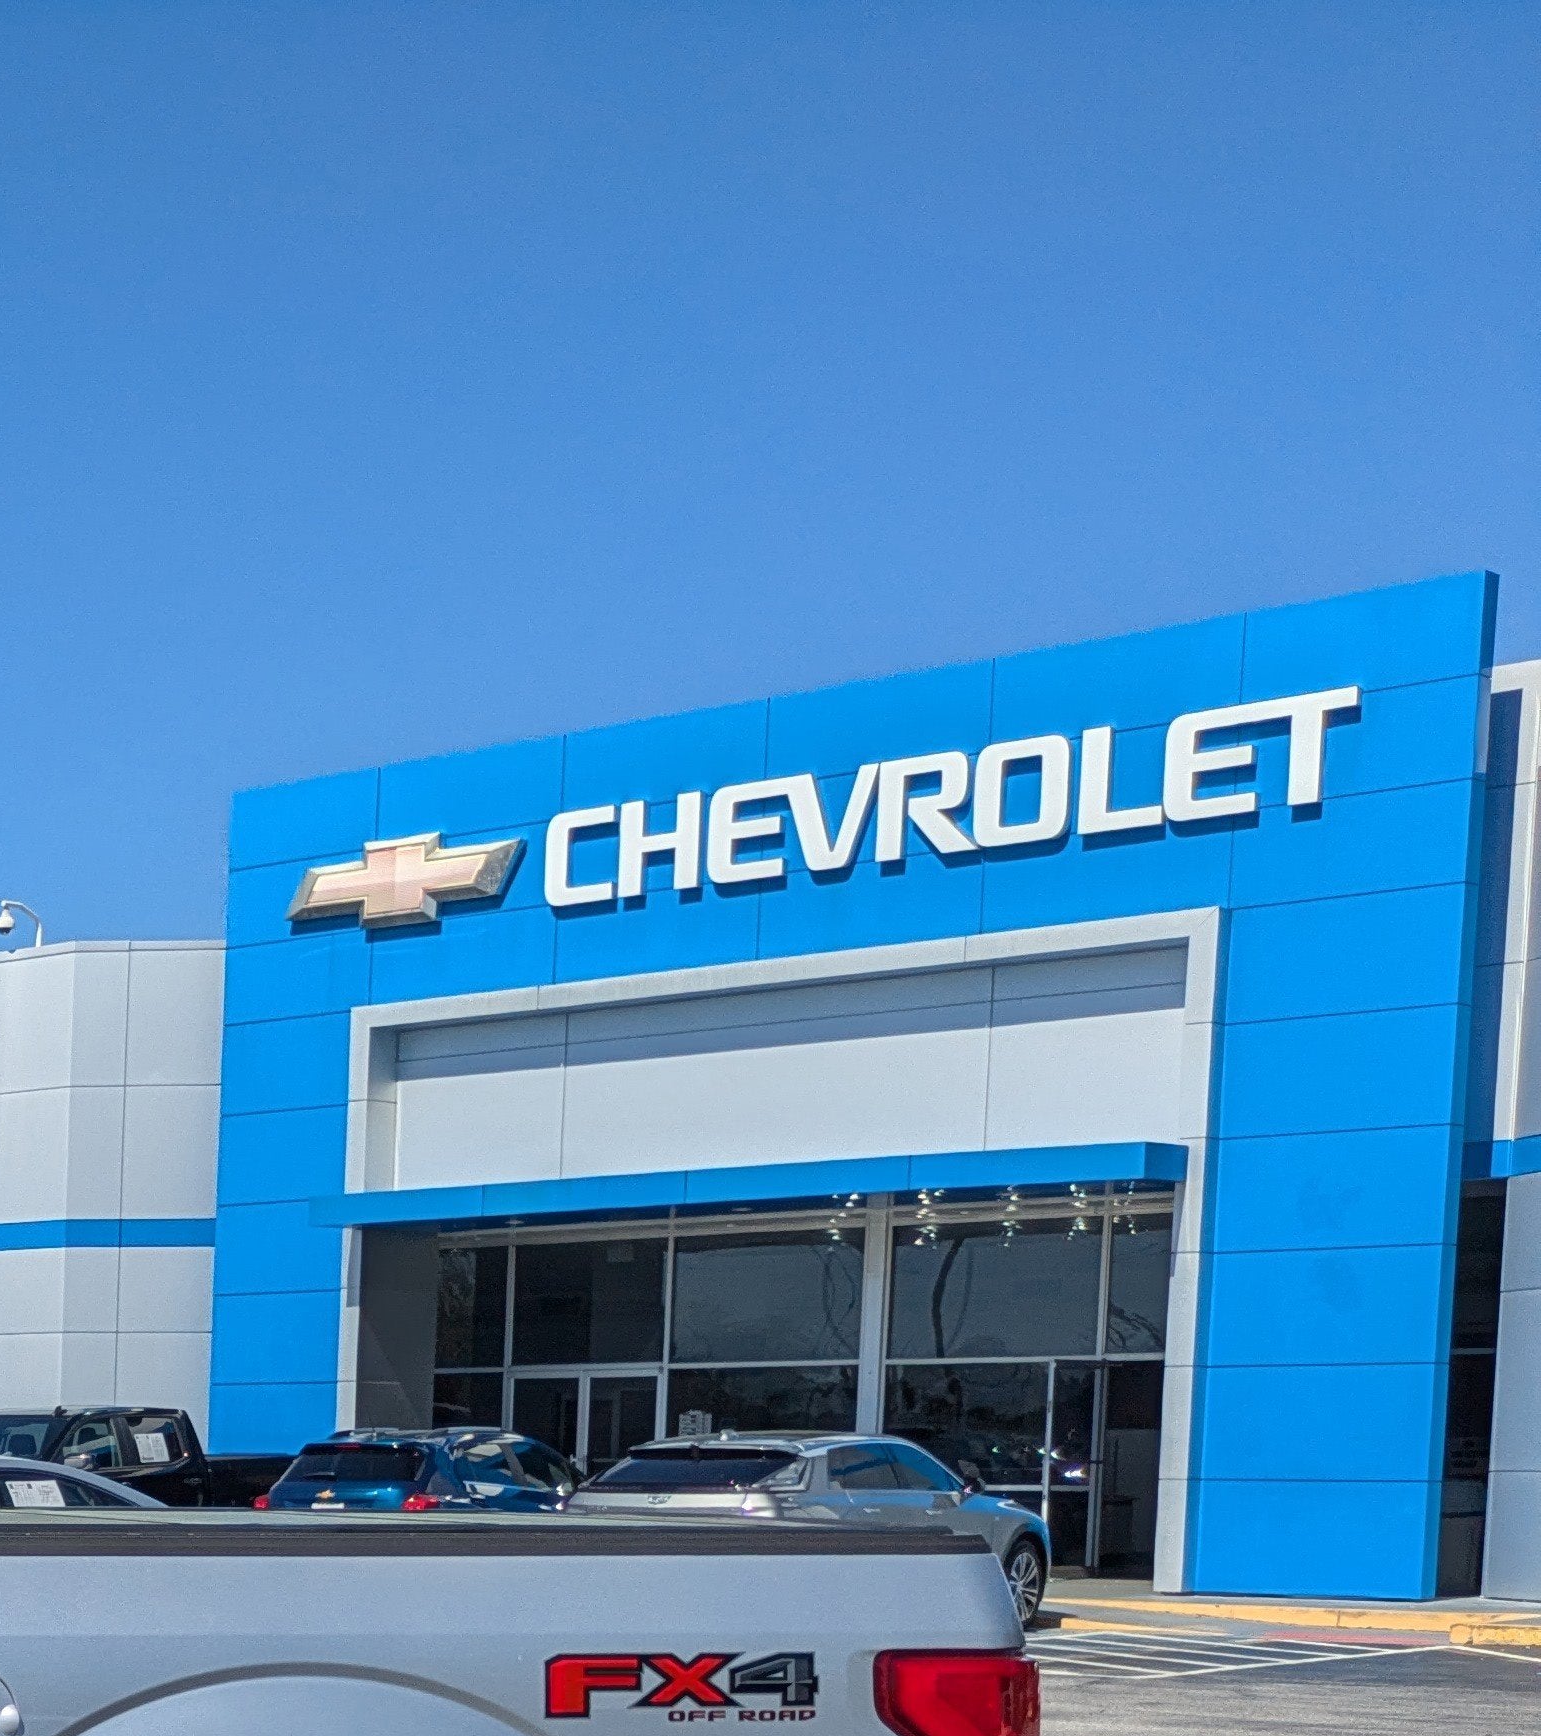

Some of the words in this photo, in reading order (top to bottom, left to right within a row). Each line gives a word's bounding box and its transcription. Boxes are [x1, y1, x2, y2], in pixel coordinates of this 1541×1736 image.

[544, 686, 1359, 906] CHEVROLET
[545, 1652, 818, 1718] FX4
[668, 1709, 727, 1722] OFF
[738, 1709, 816, 1722] ROAD
